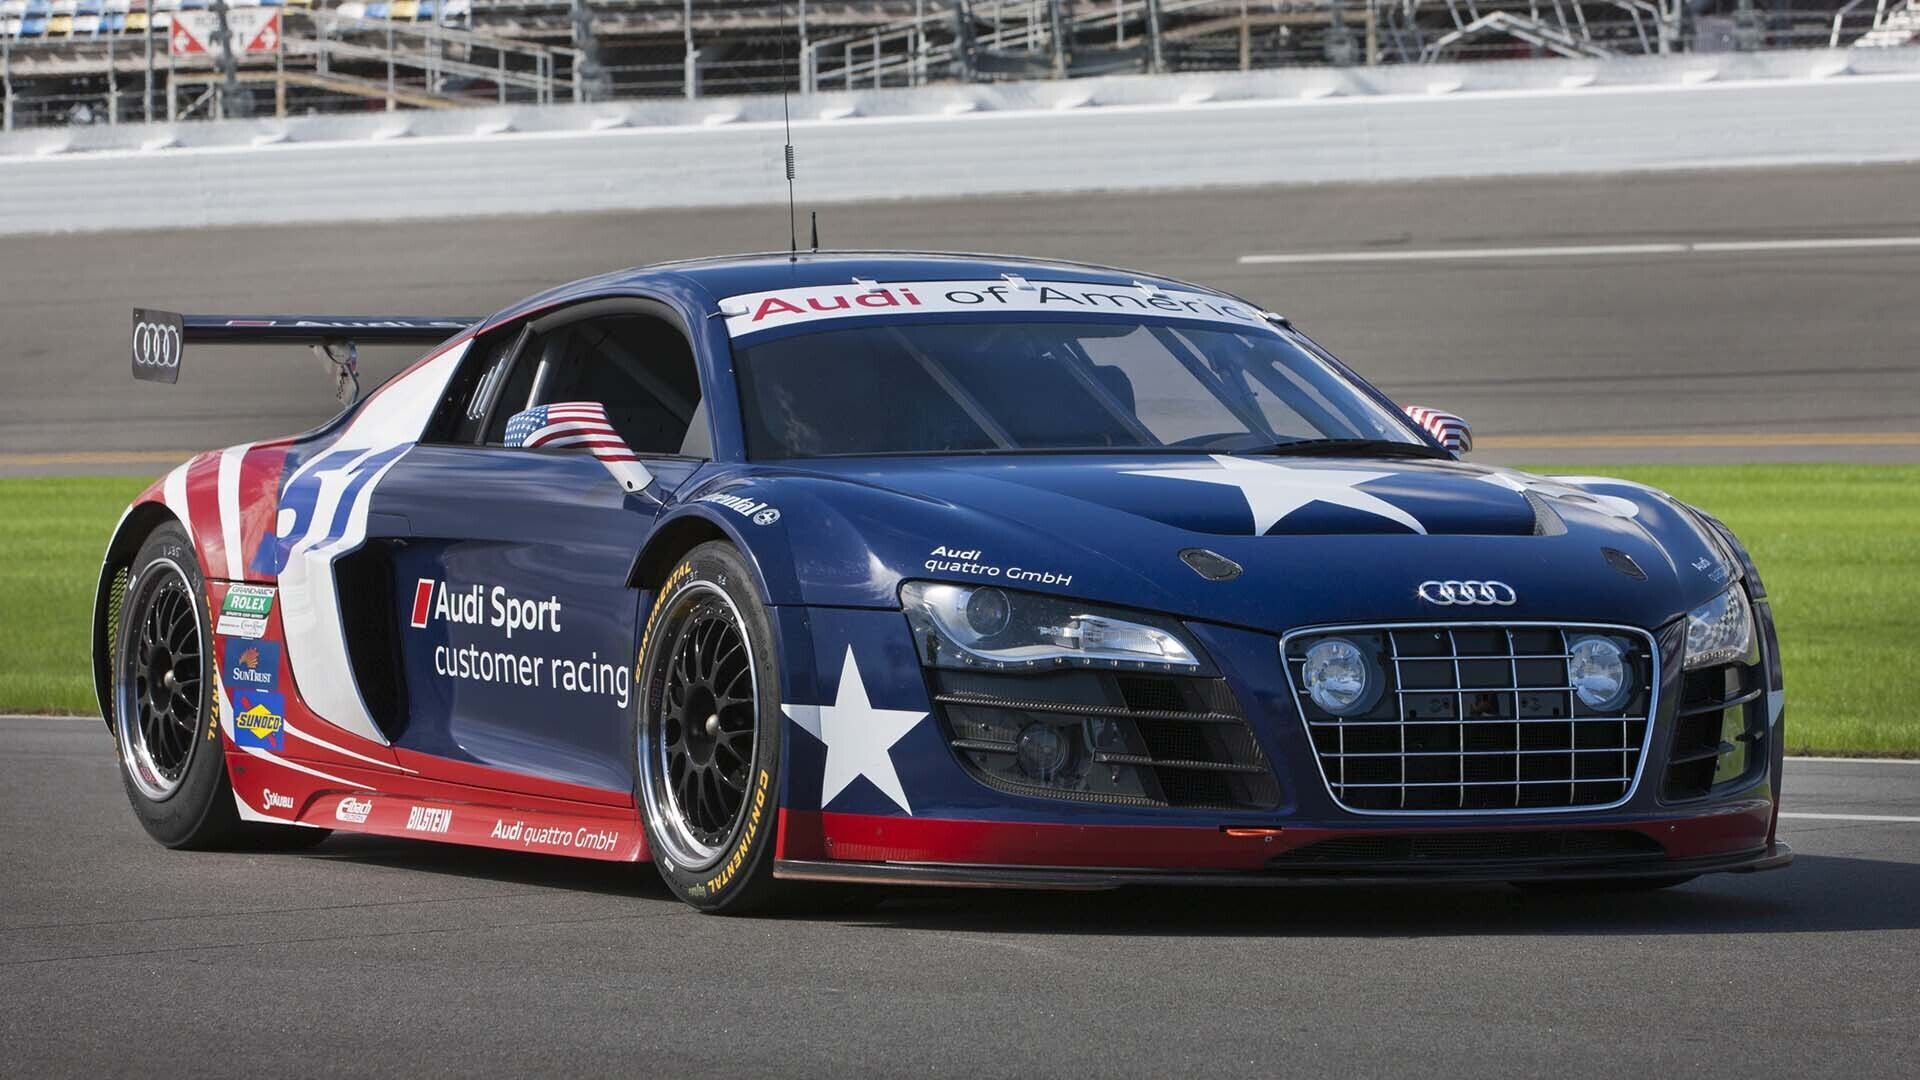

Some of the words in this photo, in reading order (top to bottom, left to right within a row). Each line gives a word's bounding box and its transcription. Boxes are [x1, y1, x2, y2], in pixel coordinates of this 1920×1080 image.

[752, 288, 923, 321] Audi
[945, 286, 1009, 304] of
[1040, 286, 1255, 321] Americ
[931, 545, 982, 561] Audi
[924, 559, 1000, 577] quattro
[1006, 567, 1073, 587] GmbH
[230, 595, 266, 611] ROLEX
[434, 581, 484, 624] Audi
[491, 586, 561, 638] Sport
[634, 561, 693, 684] CONTINENTAL
[435, 644, 543, 687] customer
[552, 652, 629, 709] racing
[239, 714, 281, 730] SUNOCO
[406, 806, 452, 833] BILSTEIN
[491, 819, 523, 841] Audi
[523, 826, 572, 846] quattro
[574, 827, 618, 851] GmbH
[706, 769, 769, 893] CONTINENTAL
